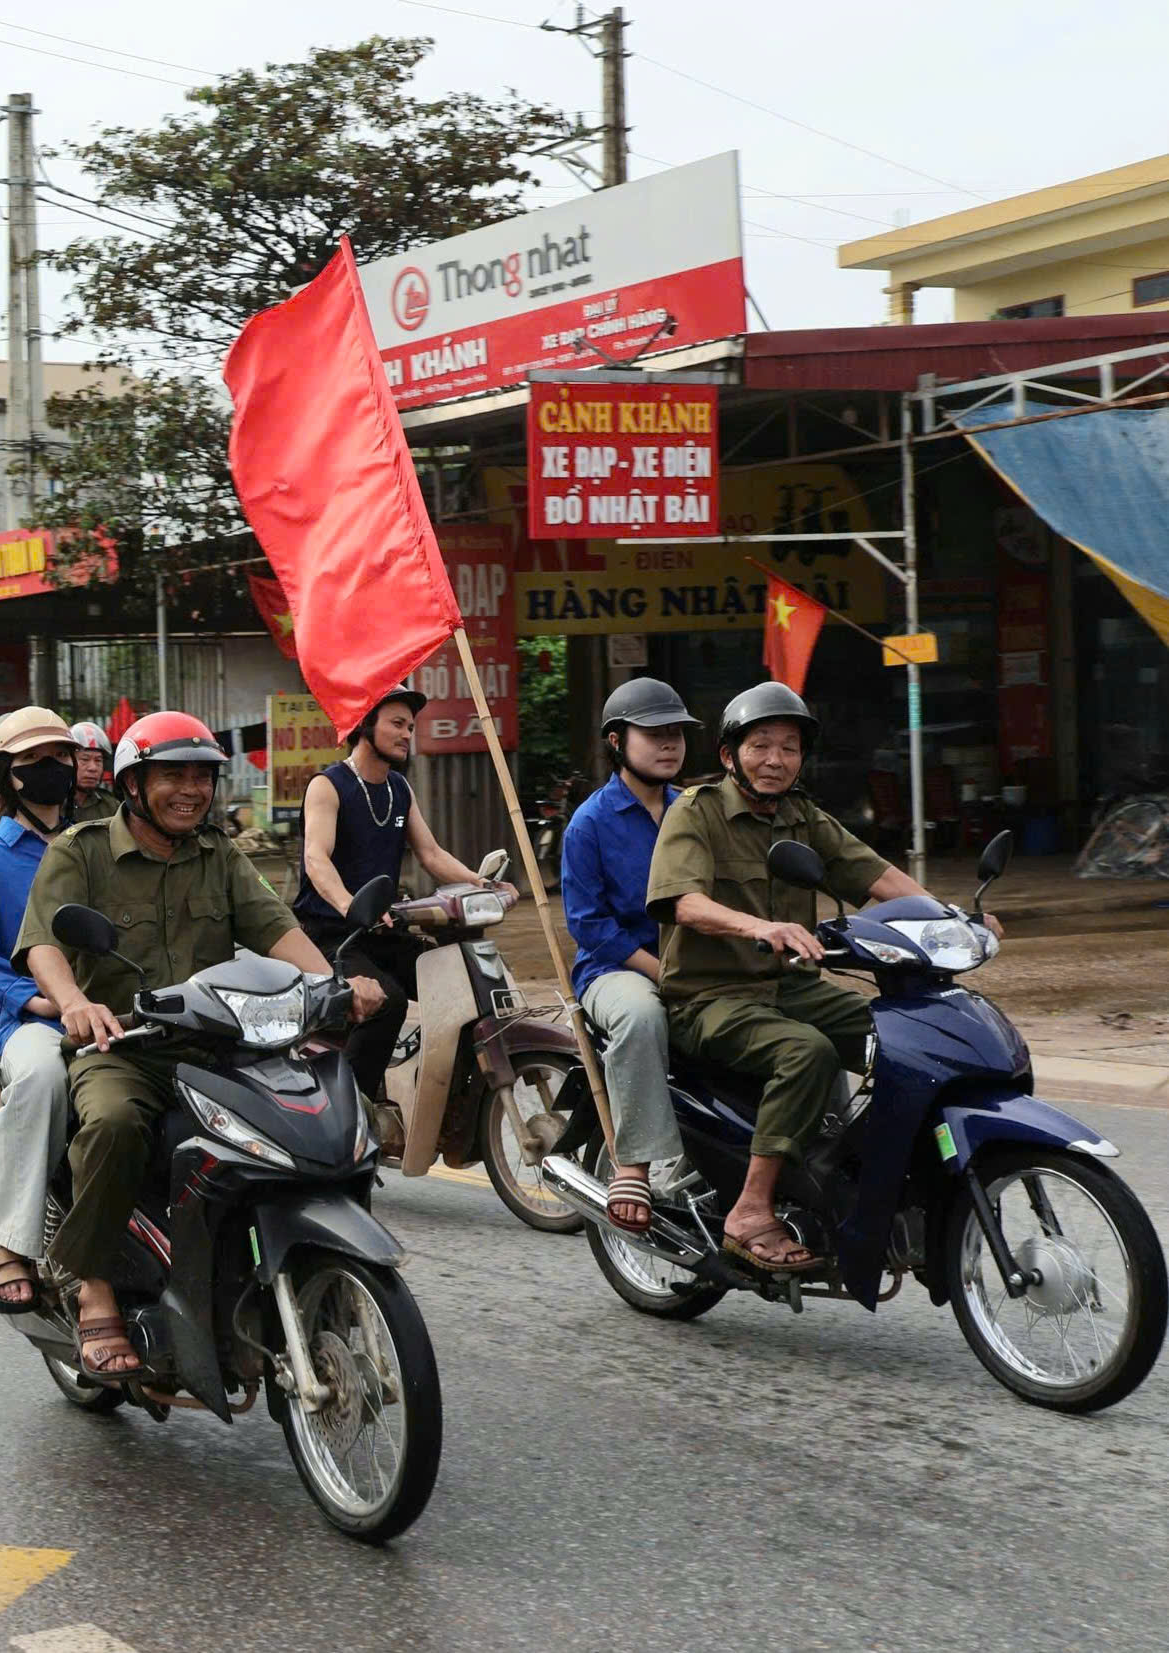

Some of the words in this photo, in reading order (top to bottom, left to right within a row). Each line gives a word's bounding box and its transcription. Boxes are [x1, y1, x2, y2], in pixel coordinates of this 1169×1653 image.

[411, 336, 488, 381] KHÁNH
[618, 392, 712, 434] KHÁNH
[541, 446, 570, 478] XE
[575, 446, 618, 485] ĐẠP
[632, 446, 660, 478] XE
[662, 440, 712, 485] ĐIỆN
[588, 488, 660, 531] NHẬT
[526, 580, 647, 620] HÀNG
[660, 576, 768, 623] NHẬT
